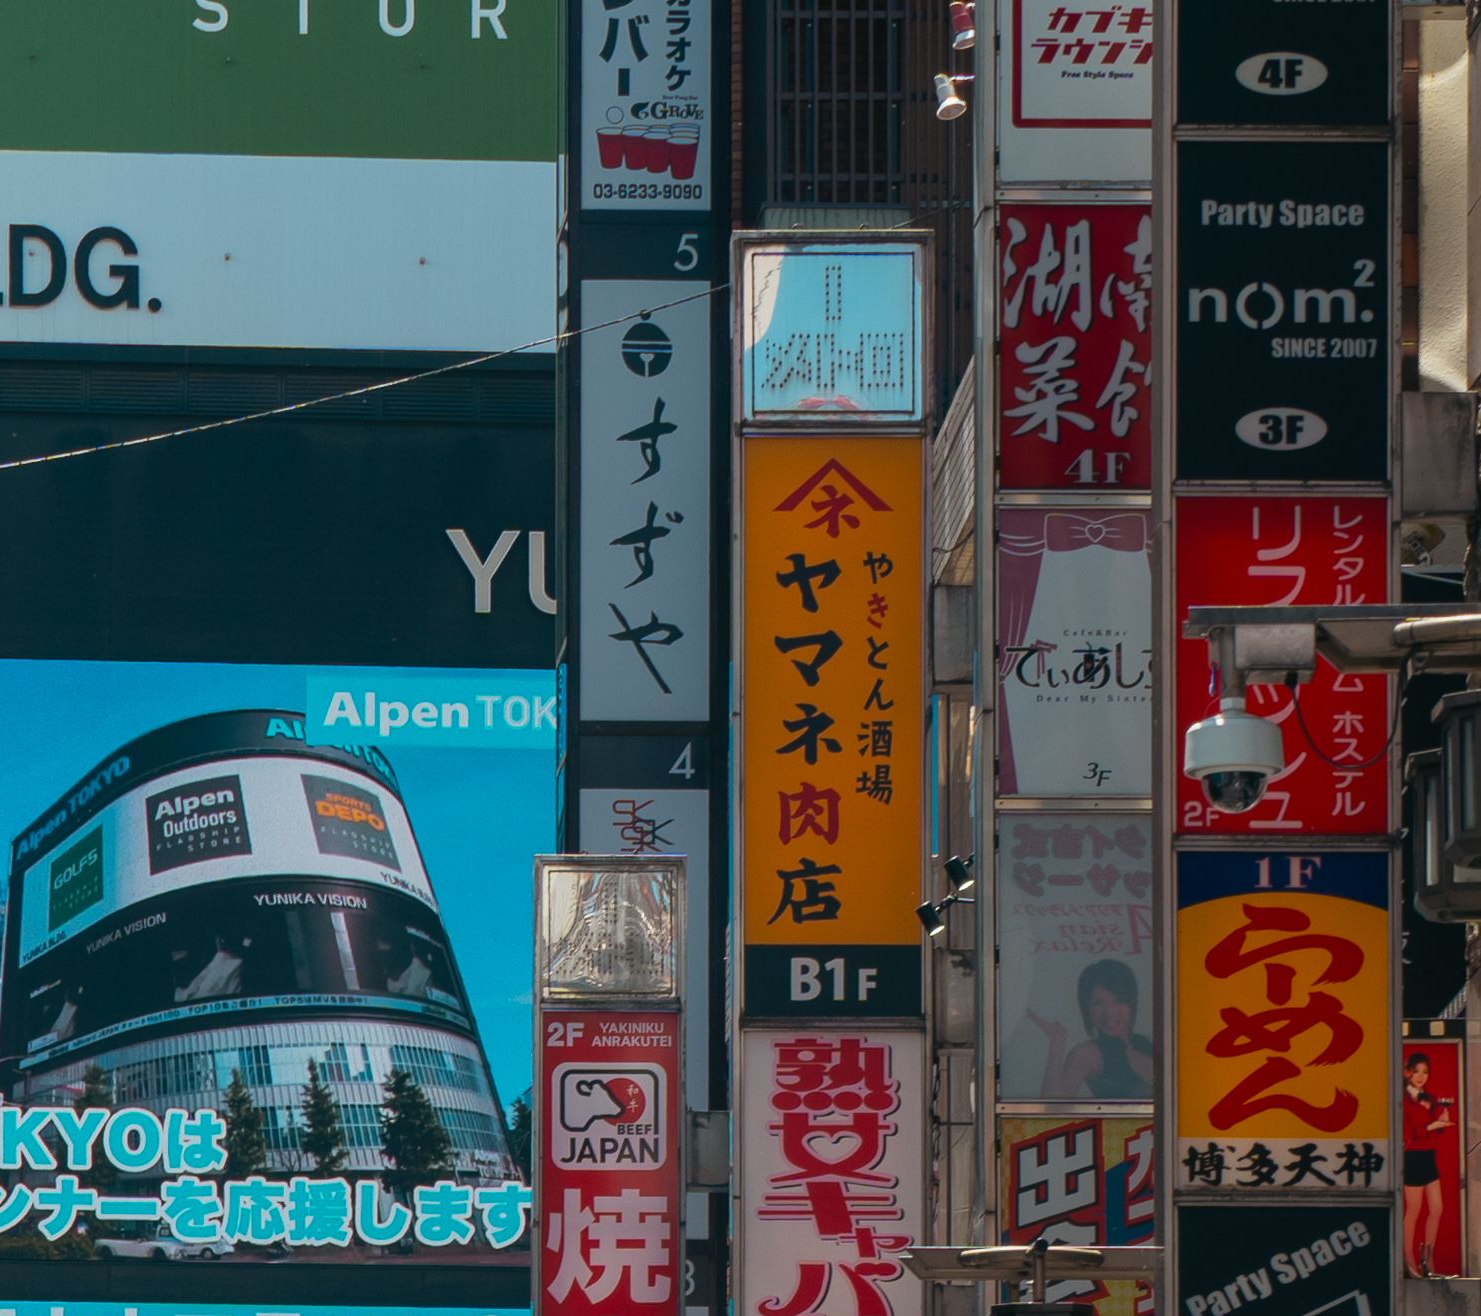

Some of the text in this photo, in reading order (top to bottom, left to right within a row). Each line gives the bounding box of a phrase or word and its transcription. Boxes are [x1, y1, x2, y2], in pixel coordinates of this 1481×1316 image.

[1258, 62, 1303, 89] 4F
[593, 183, 703, 200] 03-6233-9090
[1201, 201, 1365, 229] Party Space
[673, 233, 699, 271] 5
[1272, 338, 1378, 359] SINCE 2007
[1258, 415, 1304, 445] 3F
[1064, 450, 1131, 484] 4F
[609, 397, 684, 693] すずや
[856, 551, 895, 805] やきとん酒場
[324, 692, 469, 736] Alpen
[768, 552, 843, 925] ヤマネ肉店
[669, 741, 695, 779] 4
[1333, 711, 1365, 816] ホステル
[155, 788, 234, 821] Alpen
[163, 808, 237, 838] Outdoors
[1255, 857, 1322, 888] 1F
[254, 893, 367, 909] YUNIKA VISION
[791, 957, 877, 1001] B1F
[547, 1023, 583, 1047] 2F
[591, 1035, 672, 1048] ANRAKUTEI
[599, 1022, 665, 1034] YAKINIKU
[617, 1124, 653, 1135] BEEF
[560, 1137, 660, 1164] JAPAN
[1182, 1142, 1384, 1188] 博多天神
[1278, 1219, 1371, 1287] Space
